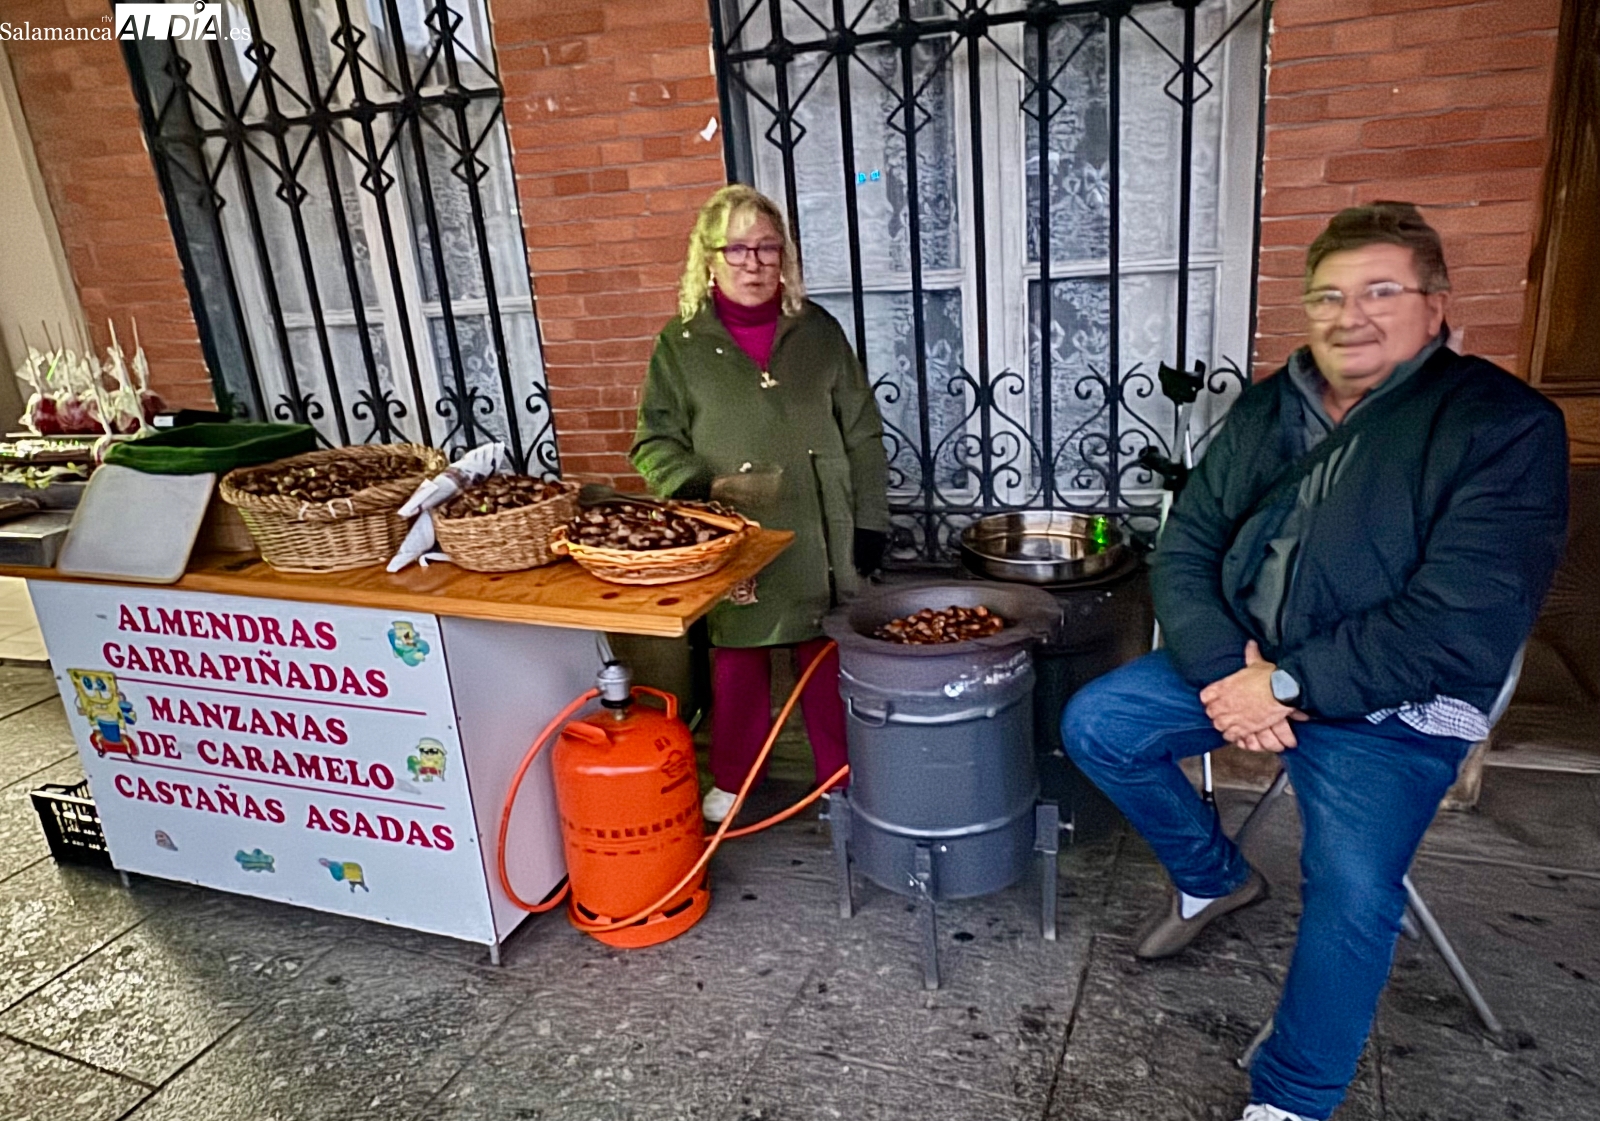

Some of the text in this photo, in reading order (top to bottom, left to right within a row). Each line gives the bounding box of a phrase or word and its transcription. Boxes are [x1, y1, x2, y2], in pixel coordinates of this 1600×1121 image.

[119, 604, 337, 651] ALMENDRAS
[102, 642, 389, 698] GARRAPIÑADAS
[147, 695, 349, 746] MANZANAS
[137, 731, 395, 791] DE CARAMELO
[114, 774, 455, 851] CASTAÑAS ASADAS
